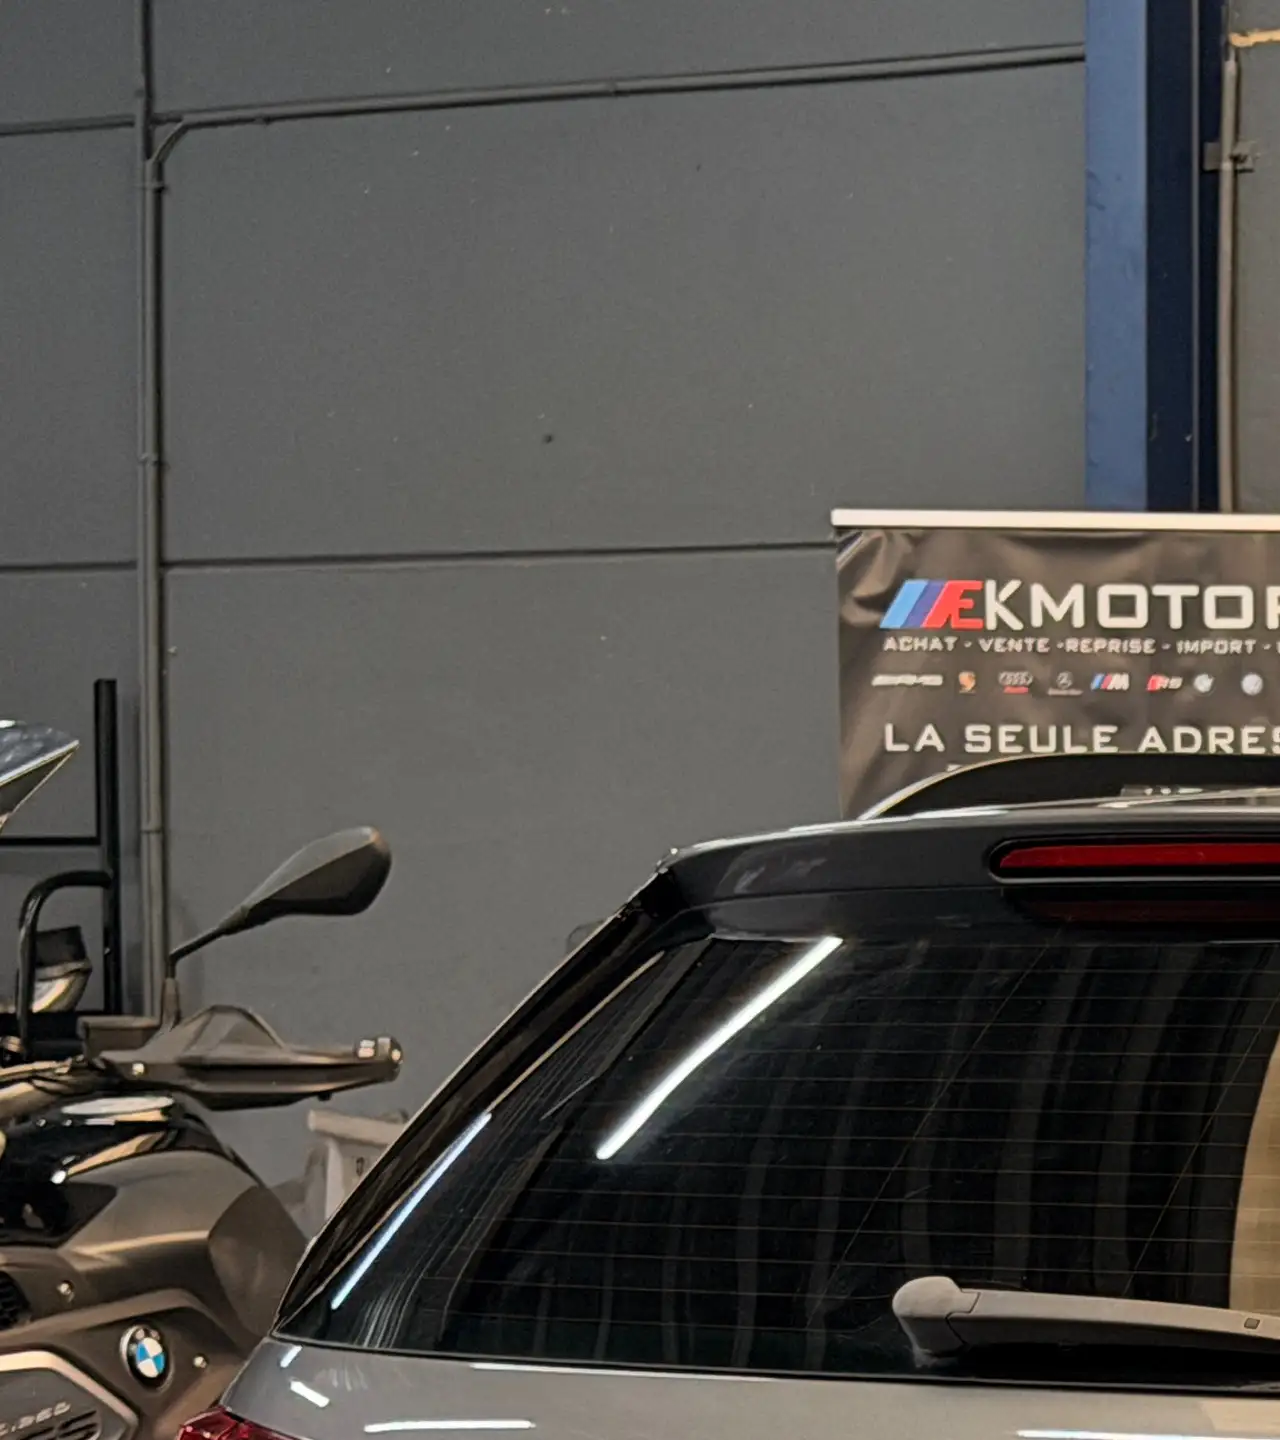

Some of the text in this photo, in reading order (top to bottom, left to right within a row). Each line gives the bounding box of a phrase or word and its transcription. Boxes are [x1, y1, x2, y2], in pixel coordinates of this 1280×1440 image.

[882, 636, 956, 652] ACHAT
[979, 638, 1050, 654] VENTE
[1177, 640, 1257, 656] IMPORT
[884, 723, 946, 753] LA
[963, 724, 1120, 754] SEULE
